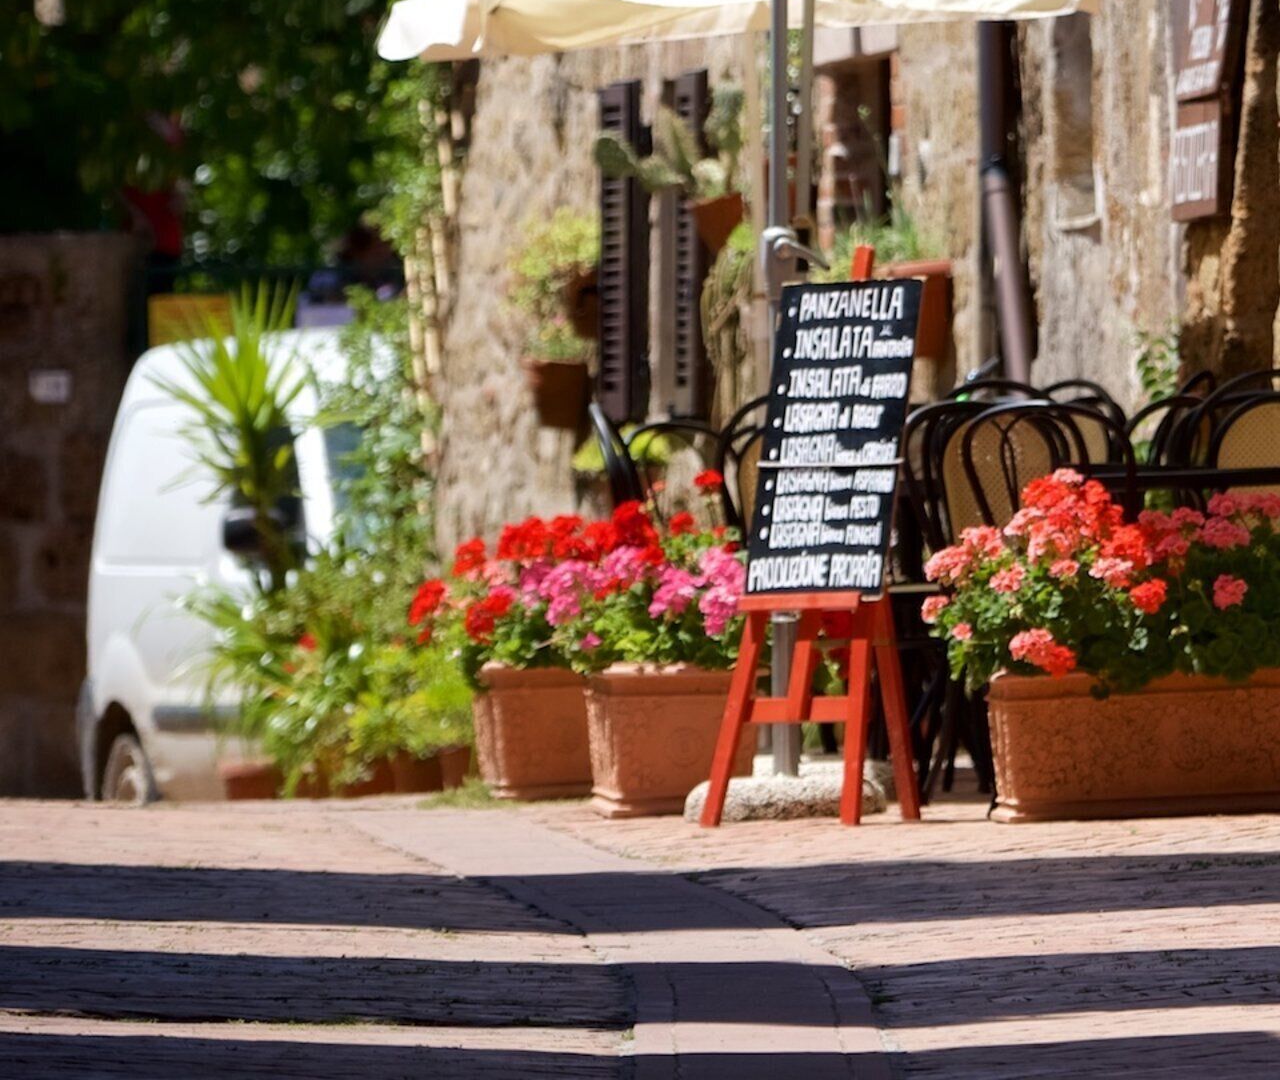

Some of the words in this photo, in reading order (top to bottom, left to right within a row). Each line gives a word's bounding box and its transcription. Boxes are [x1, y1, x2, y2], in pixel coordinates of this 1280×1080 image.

[799, 286, 904, 323] PANZANELLA
[793, 326, 873, 360] INSALATA
[786, 365, 862, 398] INSALATA
[871, 373, 908, 400] FARRO
[783, 401, 840, 434] LASAGNA
[780, 433, 837, 463] LASAGNA
[775, 467, 830, 495] LASAGNA
[772, 494, 825, 523] LASAGNA
[849, 494, 881, 519] PESTO
[769, 522, 822, 549] LASAGNA
